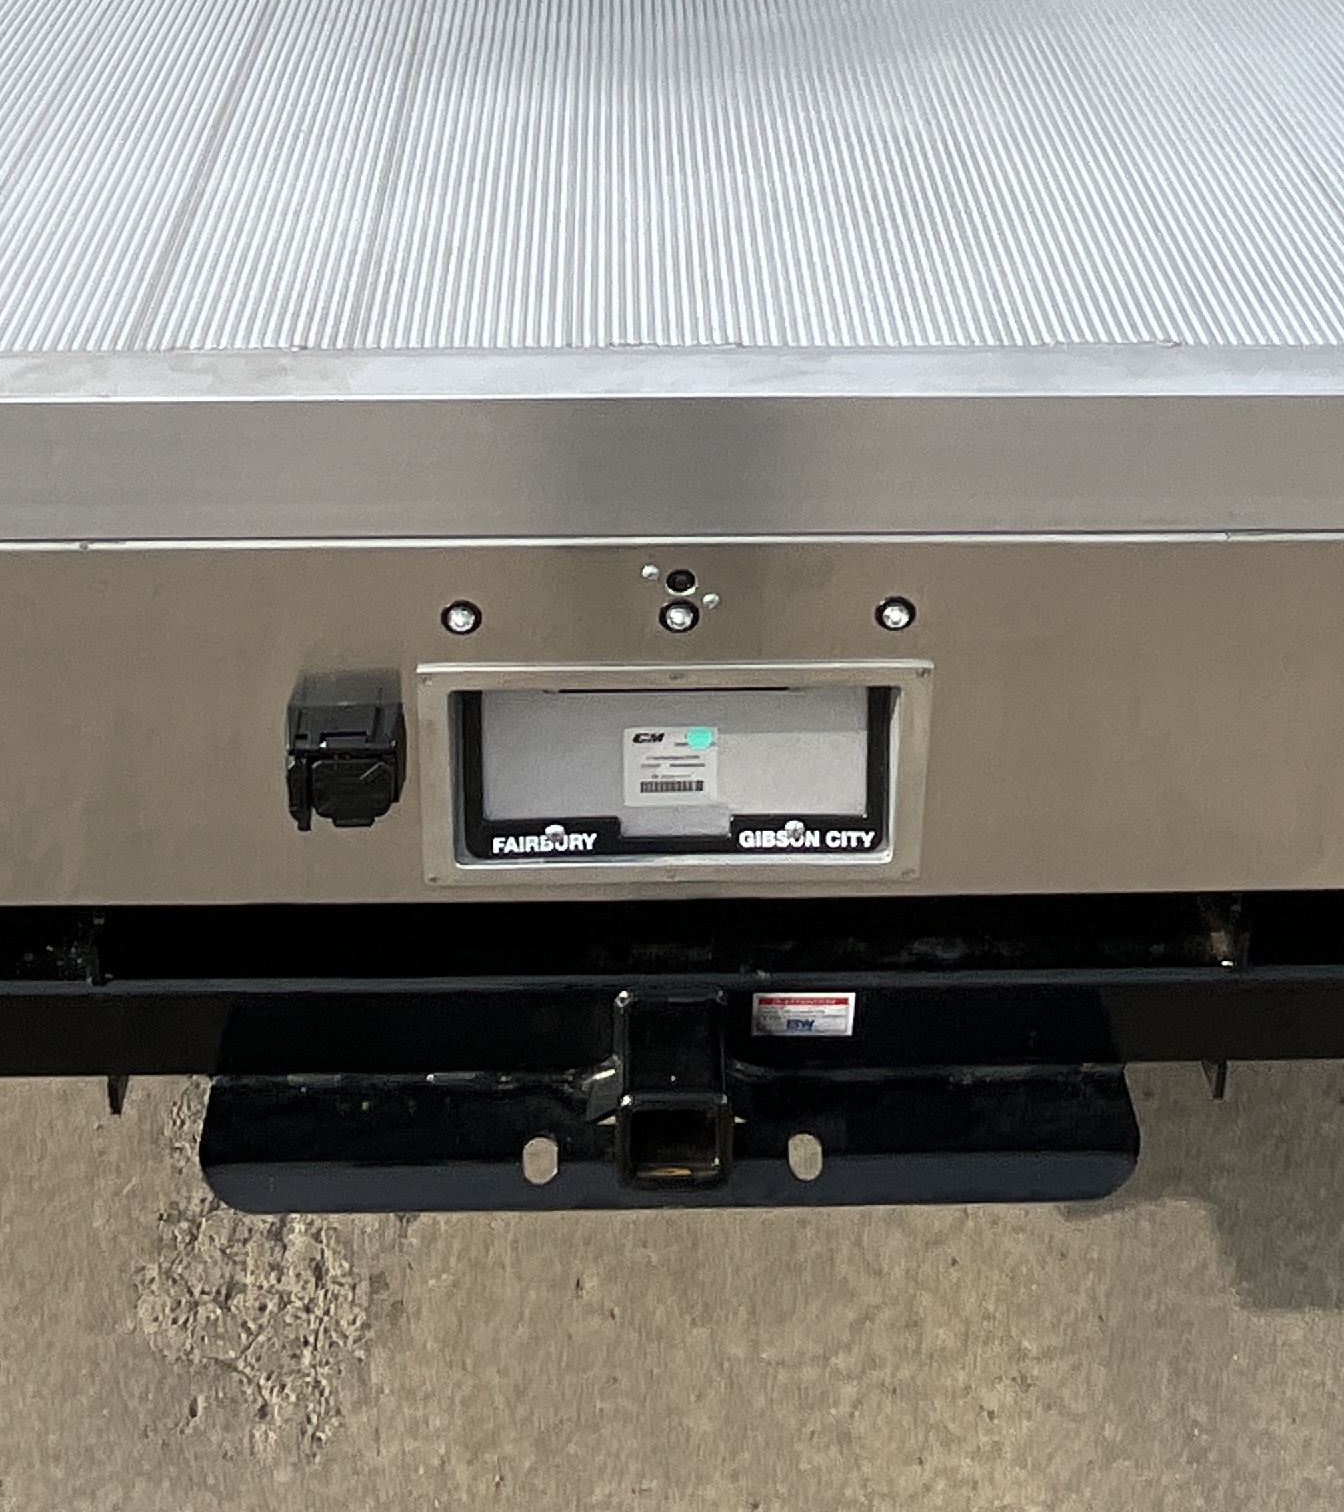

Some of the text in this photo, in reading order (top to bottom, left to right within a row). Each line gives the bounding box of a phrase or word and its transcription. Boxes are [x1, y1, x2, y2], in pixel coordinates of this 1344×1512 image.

[633, 732, 665, 744] CM
[492, 833, 597, 853] FAIRBURY
[738, 830, 875, 849] GIBSON CITY
